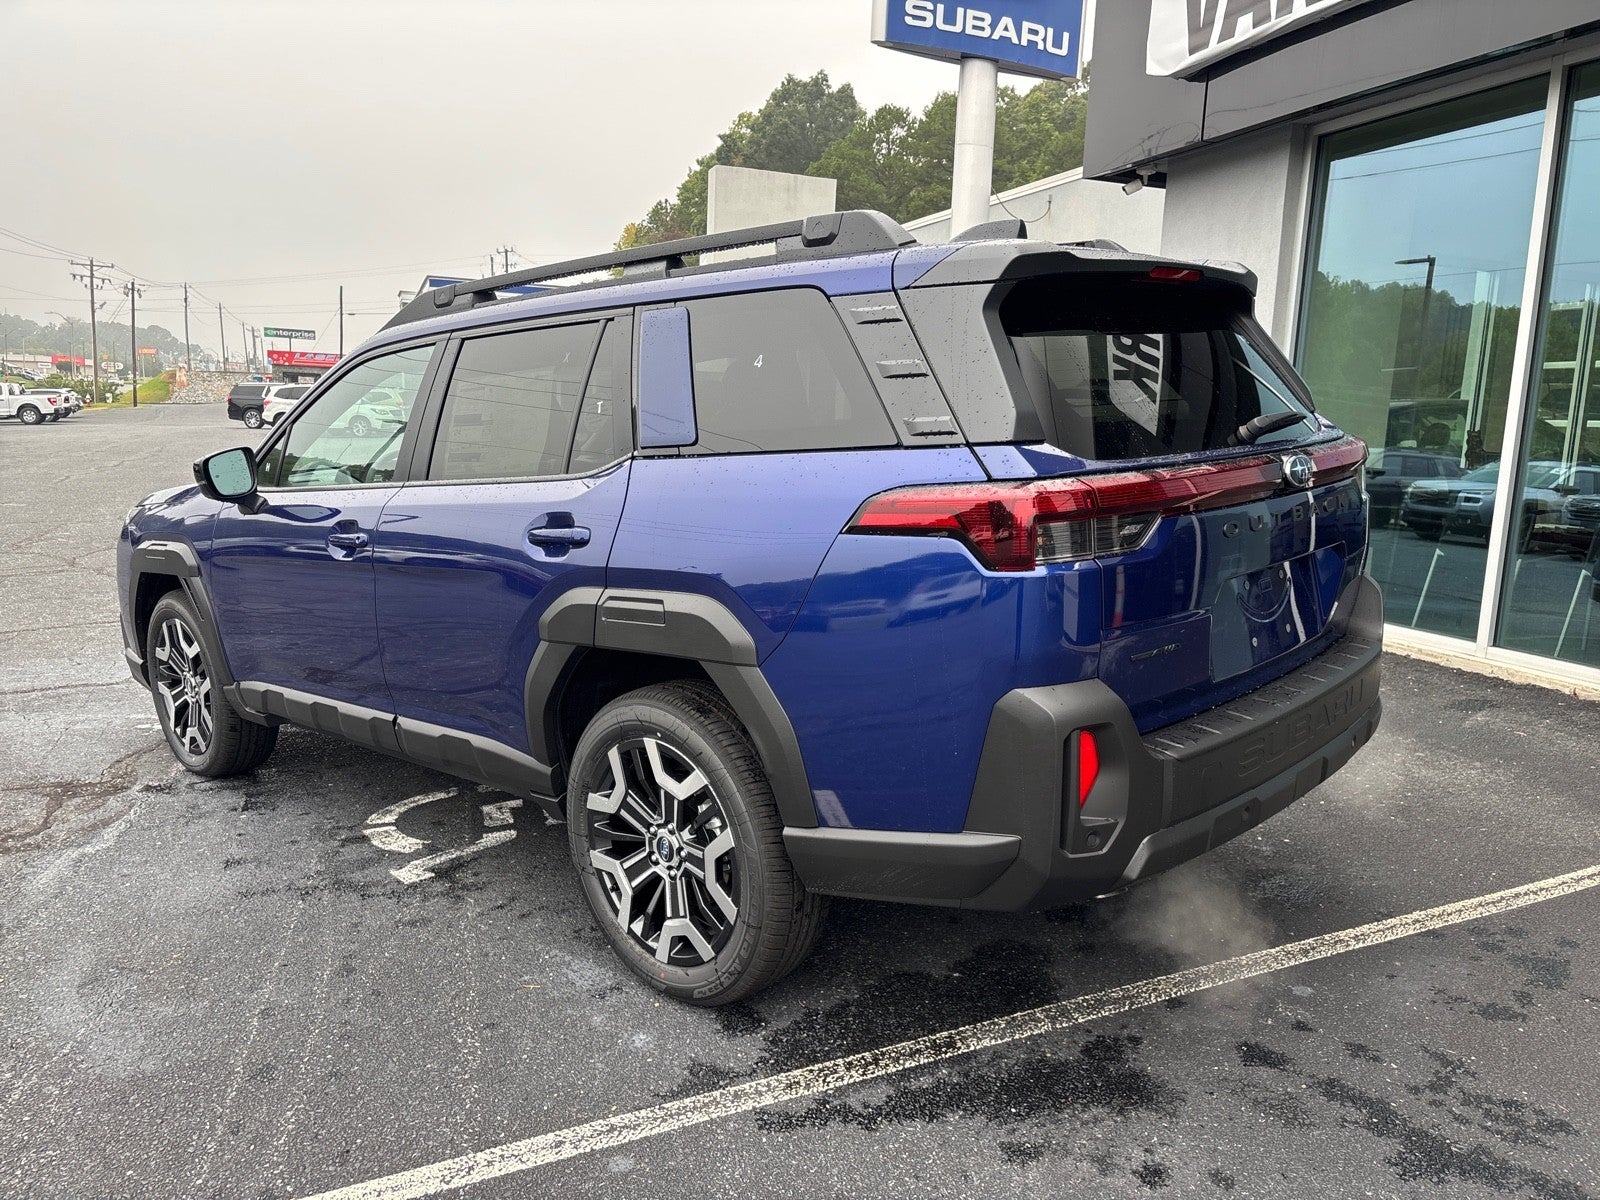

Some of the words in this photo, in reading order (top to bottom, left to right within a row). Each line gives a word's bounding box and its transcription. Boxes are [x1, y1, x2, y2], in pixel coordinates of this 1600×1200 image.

[904, 0, 1069, 57] SUBARU
[265, 329, 315, 338] enterprise
[754, 355, 762, 368] 4
[1222, 495, 1349, 539] OUTBACK
[1237, 678, 1364, 778] SUBARU
